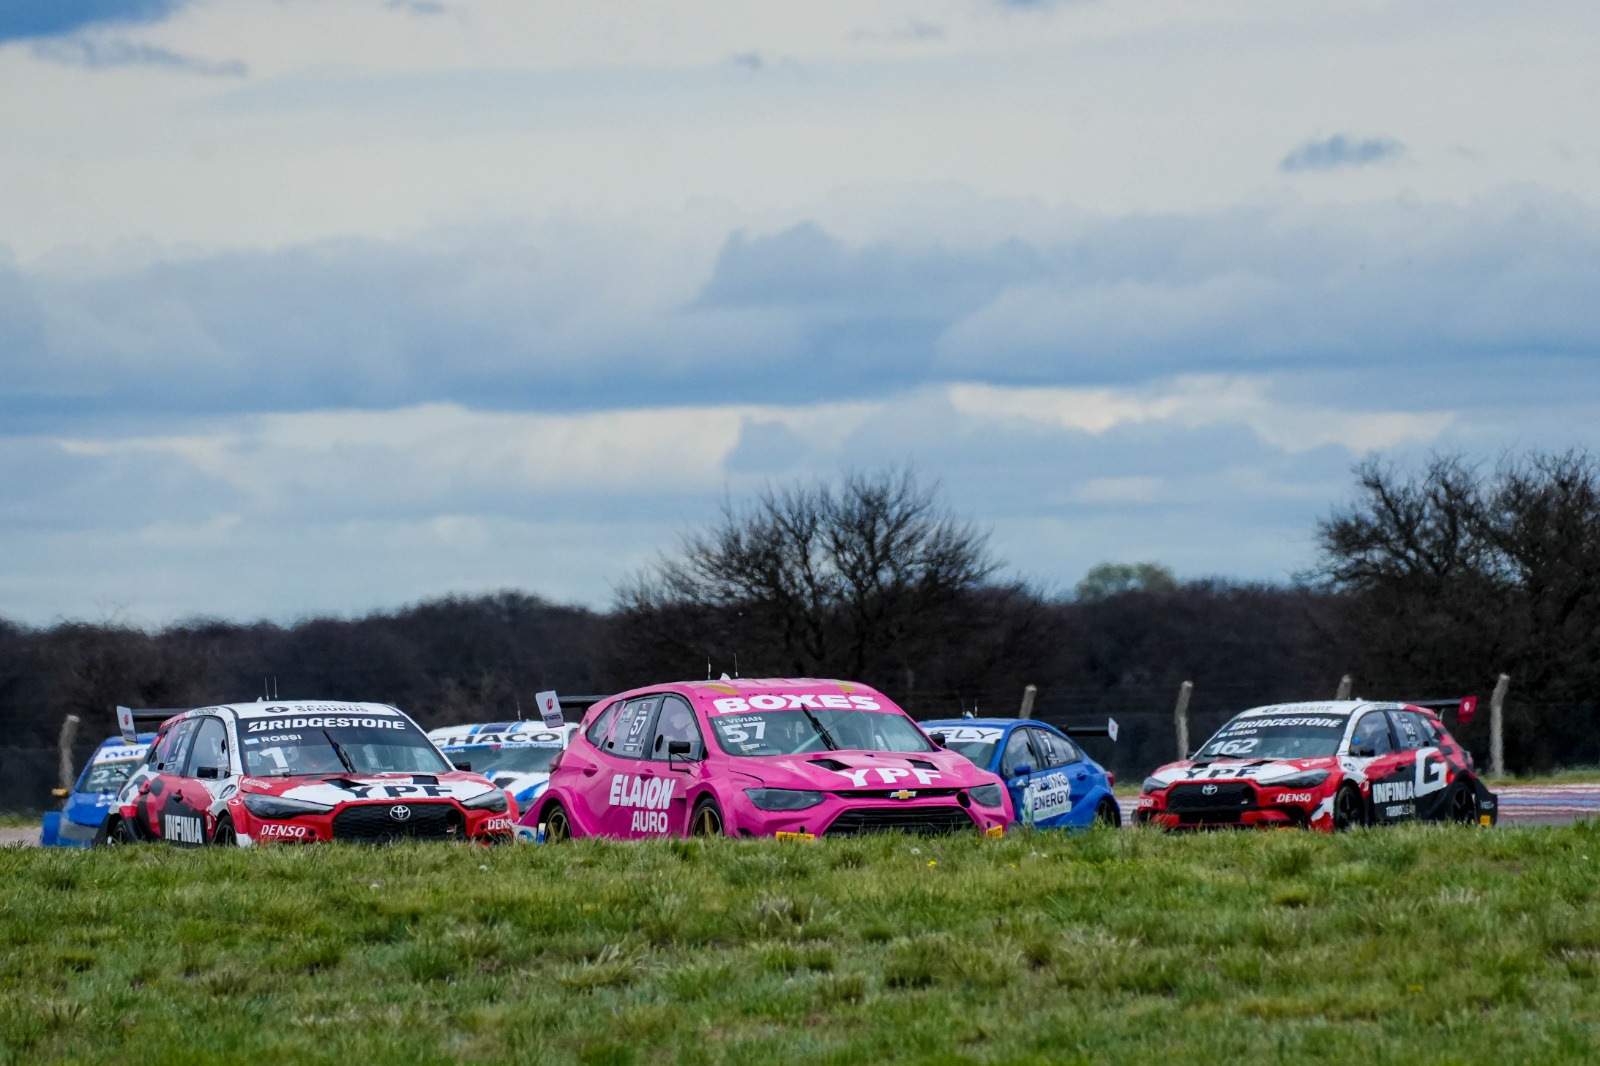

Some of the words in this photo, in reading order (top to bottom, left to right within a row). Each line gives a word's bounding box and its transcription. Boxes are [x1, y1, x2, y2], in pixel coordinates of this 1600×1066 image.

[713, 694, 881, 714] BOXES
[248, 717, 406, 733] BRIDGESTONE
[630, 716, 647, 736] 57
[722, 721, 766, 743] 57
[1228, 717, 1343, 731] BRIDGESTONE
[260, 734, 302, 743] ROSSI
[1209, 738, 1259, 756] 162
[258, 747, 289, 768] 1
[839, 768, 942, 787] YPF
[1185, 767, 1260, 780] YPF
[344, 785, 453, 798] YPF
[609, 774, 676, 810] ELAION
[1033, 790, 1069, 811] ENERGY
[1276, 793, 1312, 803] DENSO
[1372, 781, 1415, 804] INFINIA
[164, 814, 204, 844] INFINIA
[261, 824, 307, 838] DENSO
[487, 818, 513, 831] DENS
[631, 810, 669, 833] AURO
